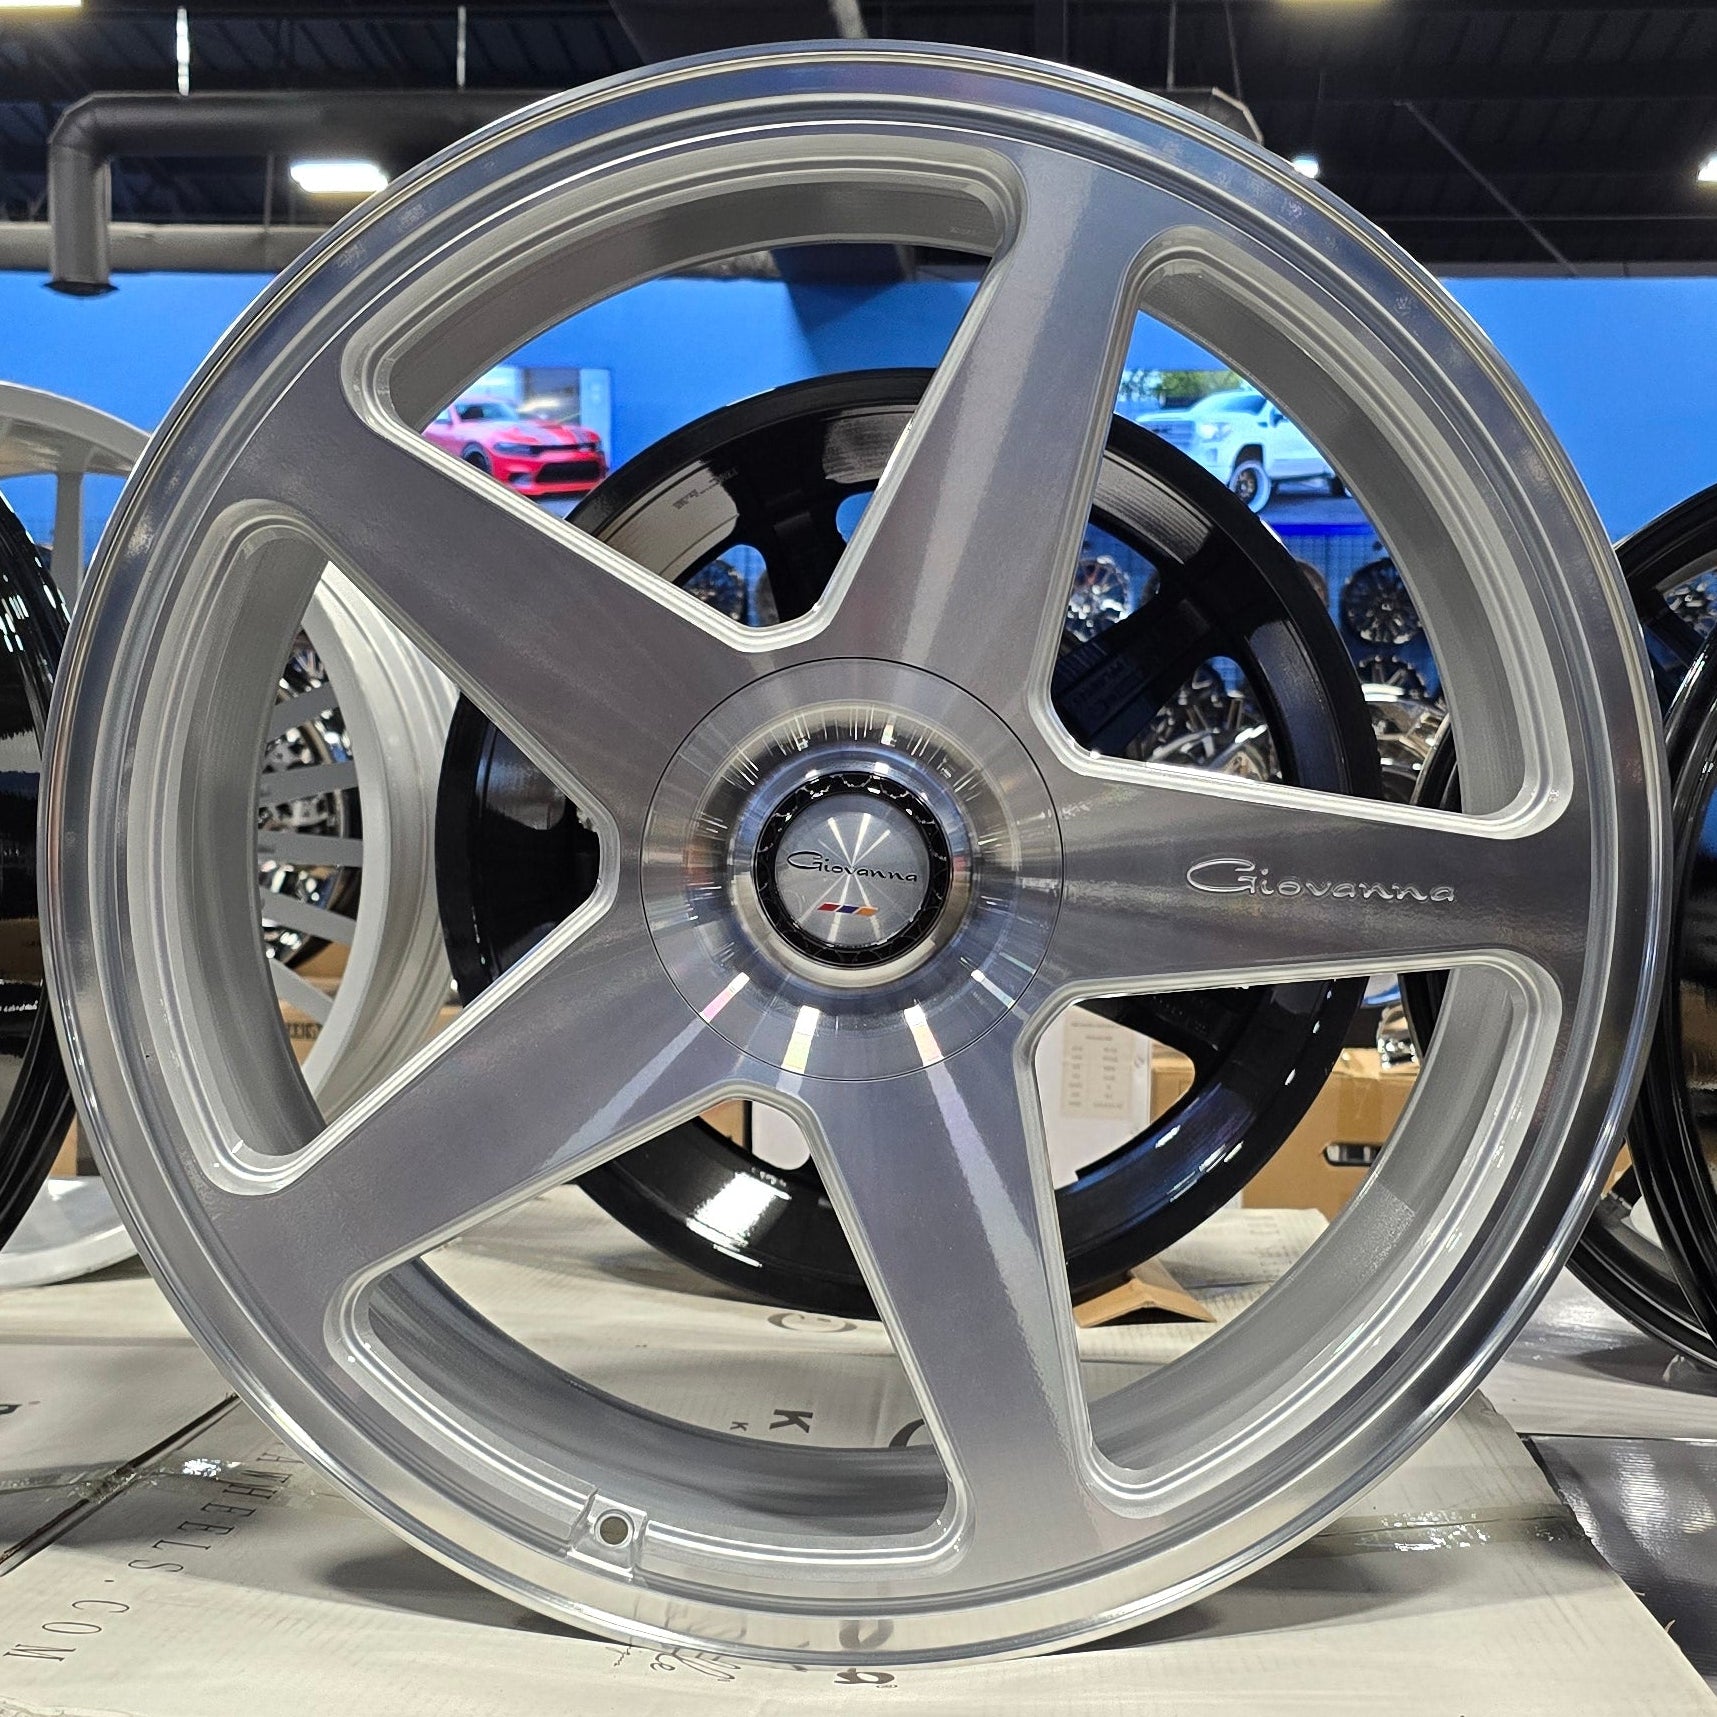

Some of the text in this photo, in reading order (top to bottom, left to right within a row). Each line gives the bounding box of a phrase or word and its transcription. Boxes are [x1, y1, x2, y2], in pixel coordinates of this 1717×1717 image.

[787, 850, 918, 882] Giovanna
[1187, 857, 1454, 902] Giovanna
[3, 1444, 304, 1662] AWHEELS.COM
